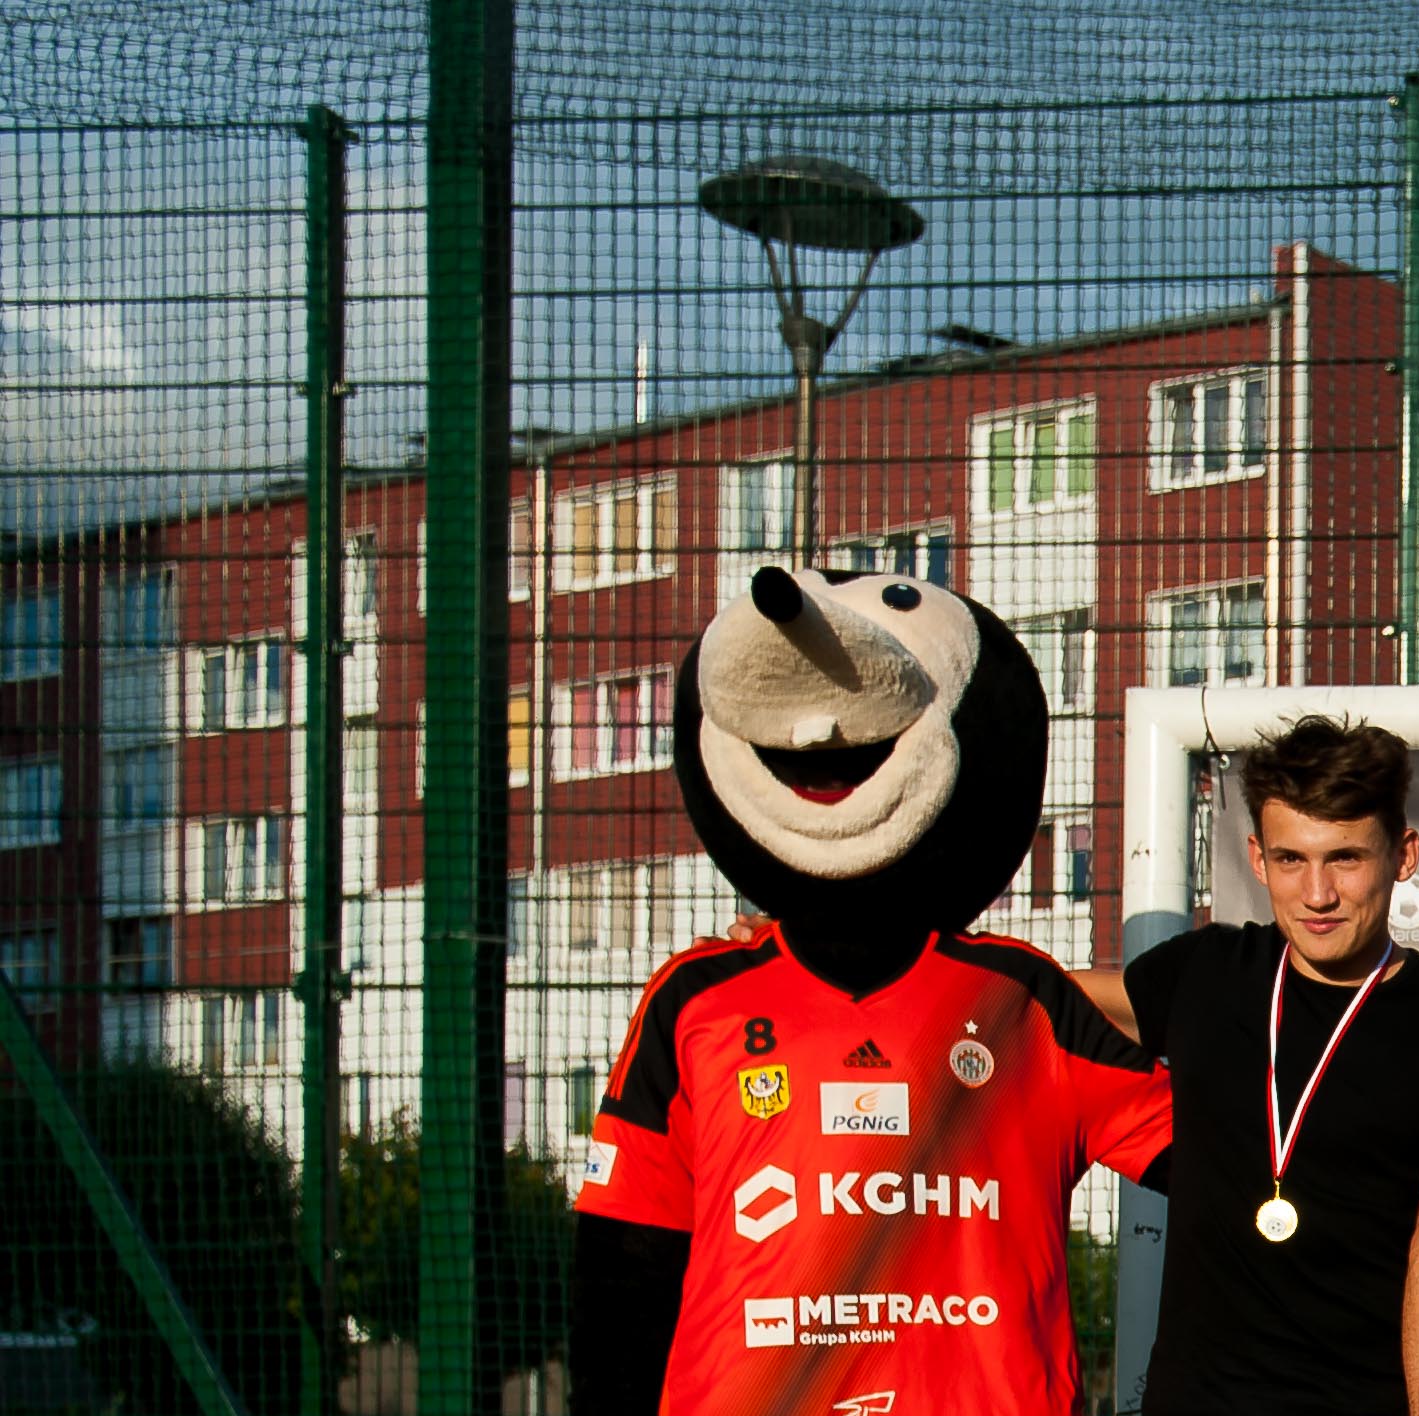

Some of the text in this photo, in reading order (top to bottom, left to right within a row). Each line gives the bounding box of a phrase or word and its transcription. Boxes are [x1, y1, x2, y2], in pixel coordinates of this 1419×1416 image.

[744, 1017, 777, 1055] 8
[832, 1115, 900, 1132] PGNiG
[818, 1171, 1000, 1221] KGHM
[799, 1293, 999, 1326] METRACO
[799, 1330, 895, 1347] Grupa KGHM
